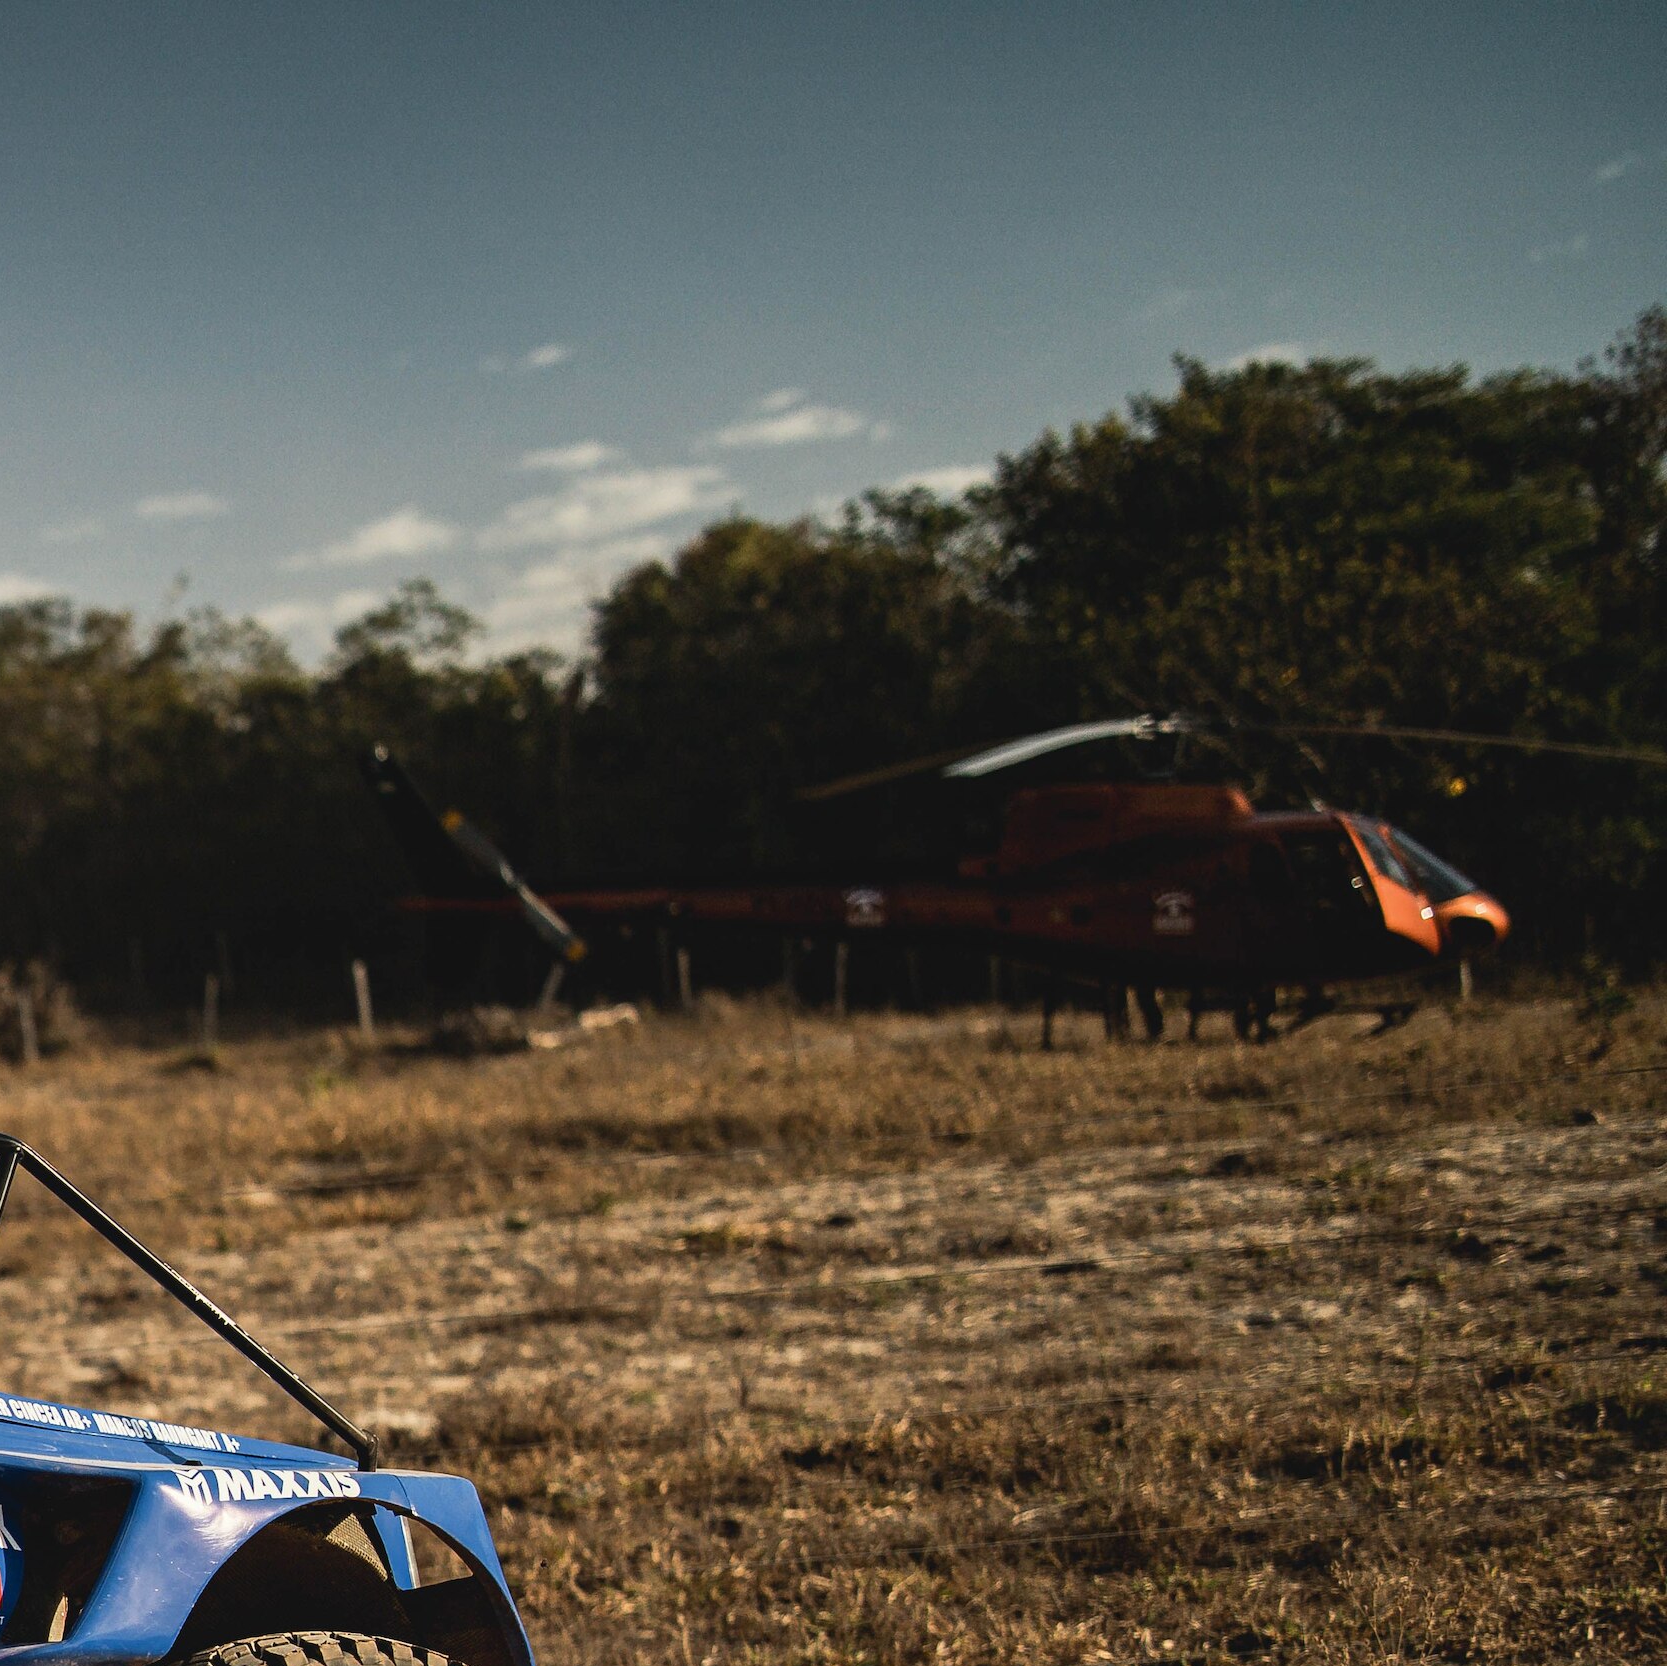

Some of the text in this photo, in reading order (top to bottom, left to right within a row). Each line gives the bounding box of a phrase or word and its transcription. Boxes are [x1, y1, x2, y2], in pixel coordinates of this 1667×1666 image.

[92, 1413, 153, 1440] MARCOS
[150, 1421, 223, 1452] BAUMGART
[215, 1468, 361, 1501] MAXXIS
